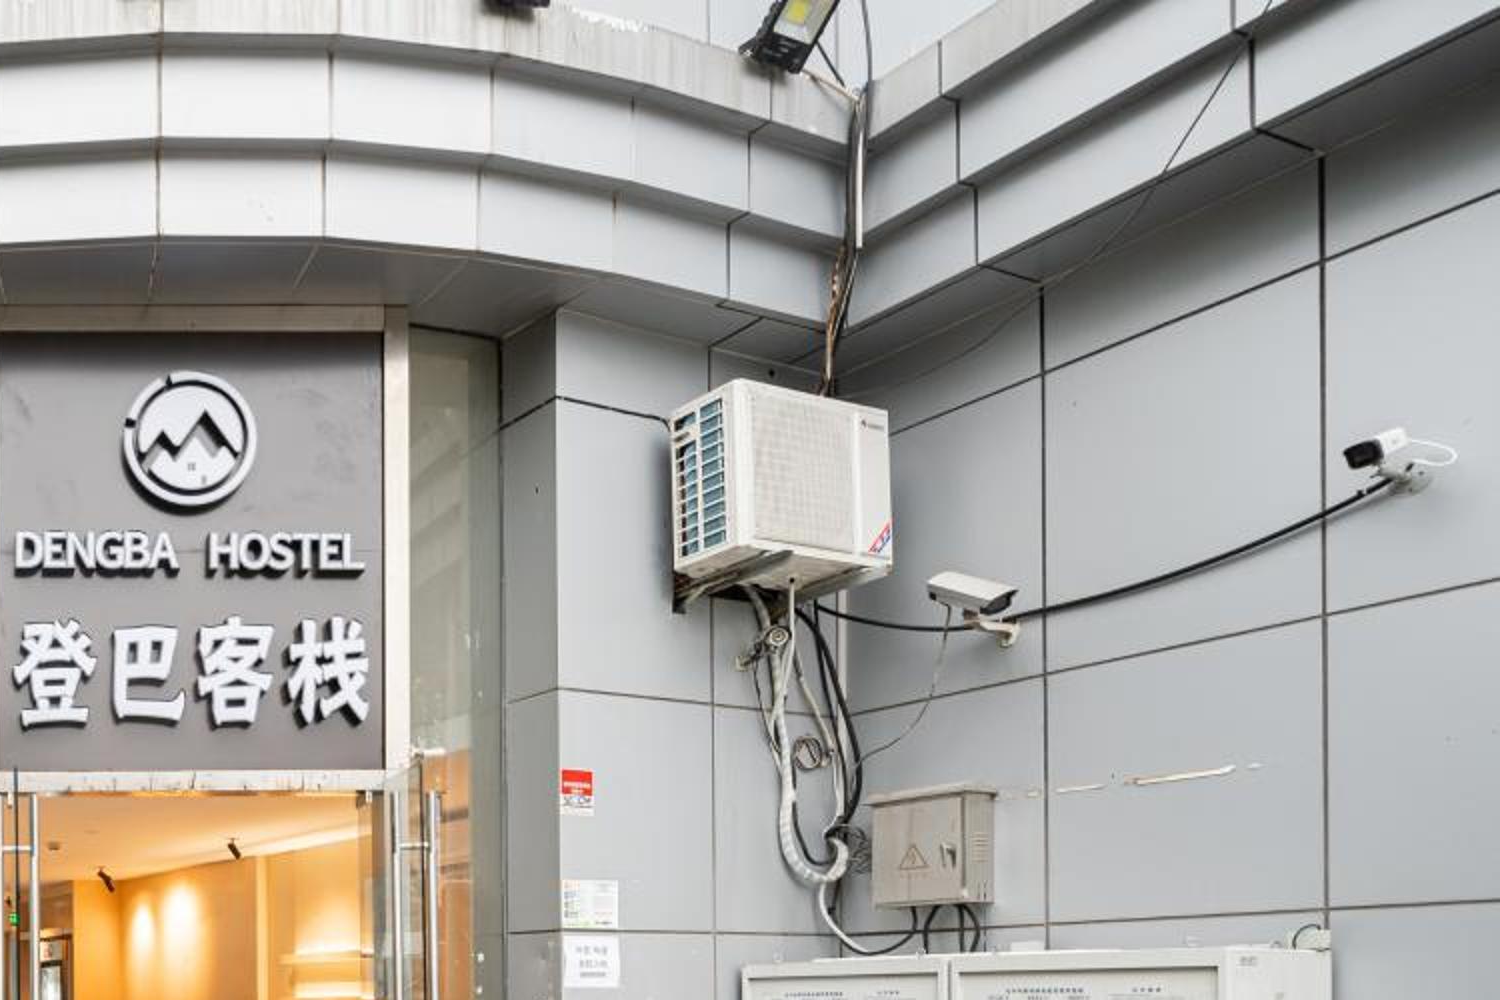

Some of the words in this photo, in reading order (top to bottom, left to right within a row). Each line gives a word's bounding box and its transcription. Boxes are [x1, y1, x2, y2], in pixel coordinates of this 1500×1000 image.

[13, 531, 179, 573] DENGBA
[207, 531, 365, 573] HOSTEL
[12, 616, 370, 729] 登巴客栈
